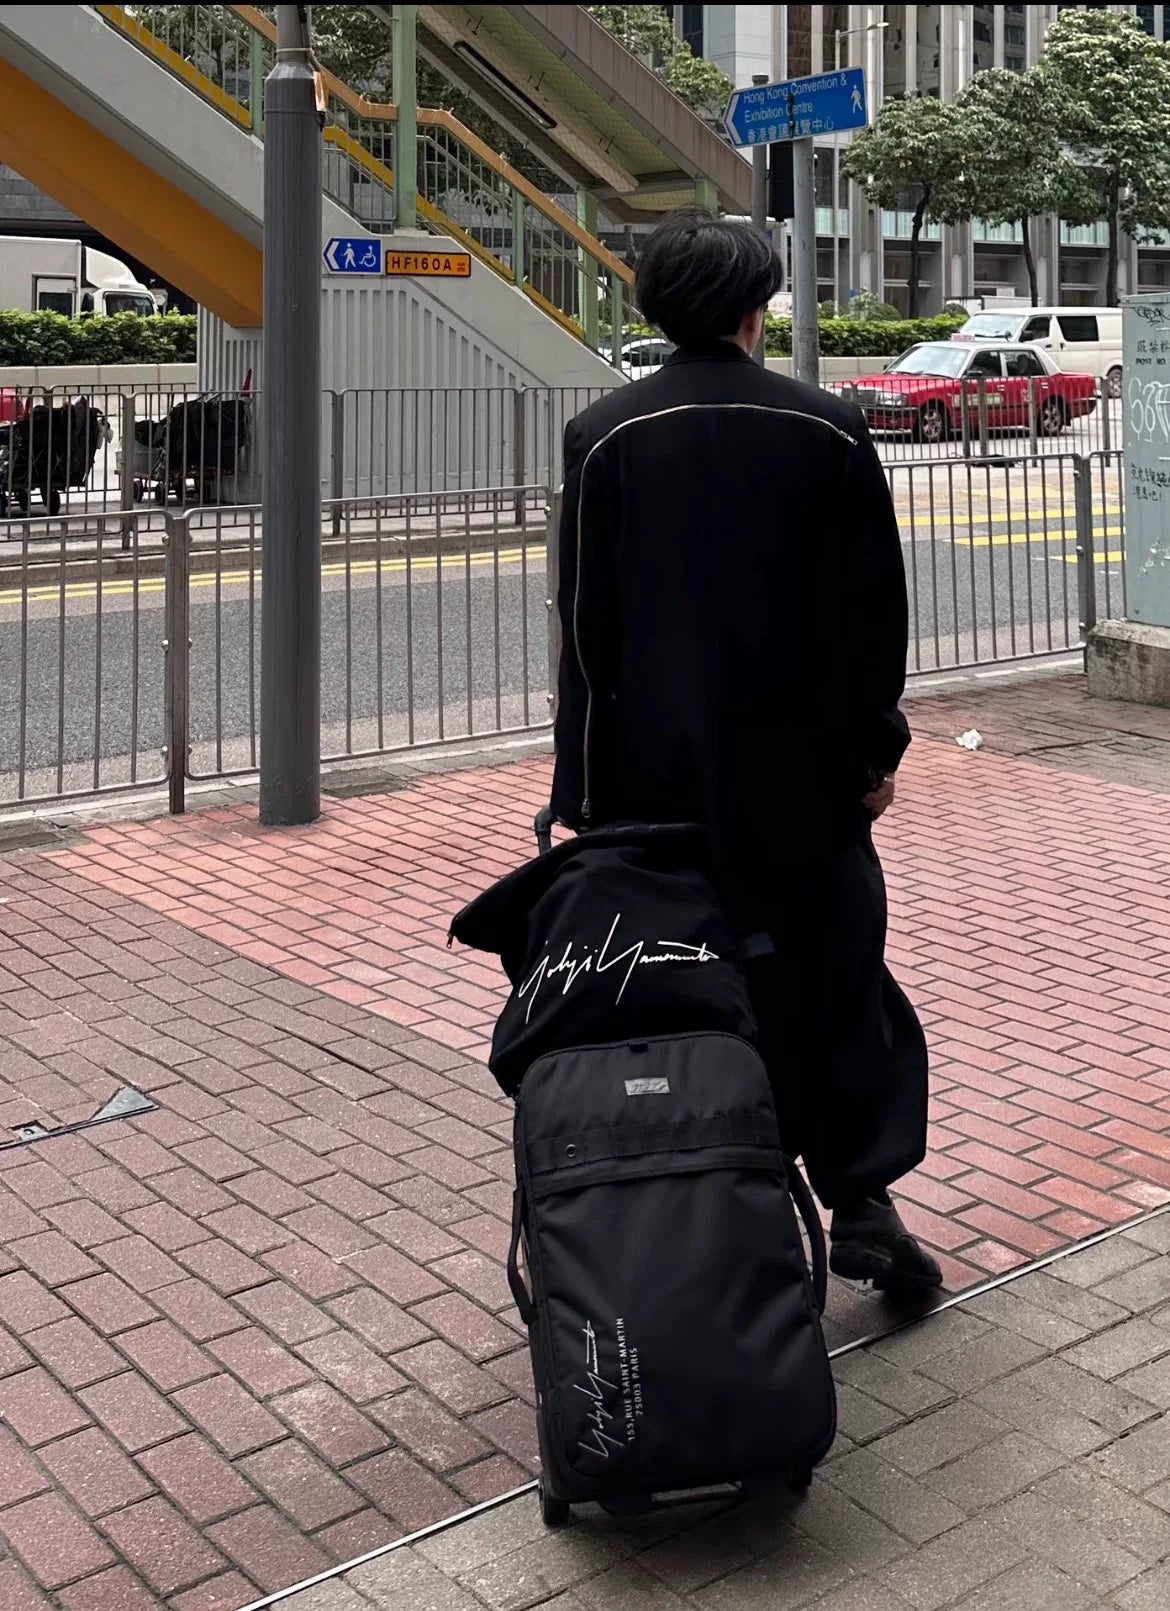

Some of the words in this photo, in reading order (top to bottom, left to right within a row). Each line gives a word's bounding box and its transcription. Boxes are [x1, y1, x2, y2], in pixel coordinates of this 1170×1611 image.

[743, 90, 765, 105] Hong
[766, 87, 788, 101] Kong
[790, 77, 838, 95] Convention
[840, 72, 847, 86] &
[744, 106, 783, 123] Exhibition
[785, 102, 813, 116] Centre
[391, 256, 452, 271] HF160A
[1135, 357, 1152, 365] POST
[1156, 357, 1166, 365] NO
[616, 1318, 631, 1394] SAINT-MARTIN
[630, 1348, 641, 1379] PARIS
[633, 1383, 644, 1416] 75003
